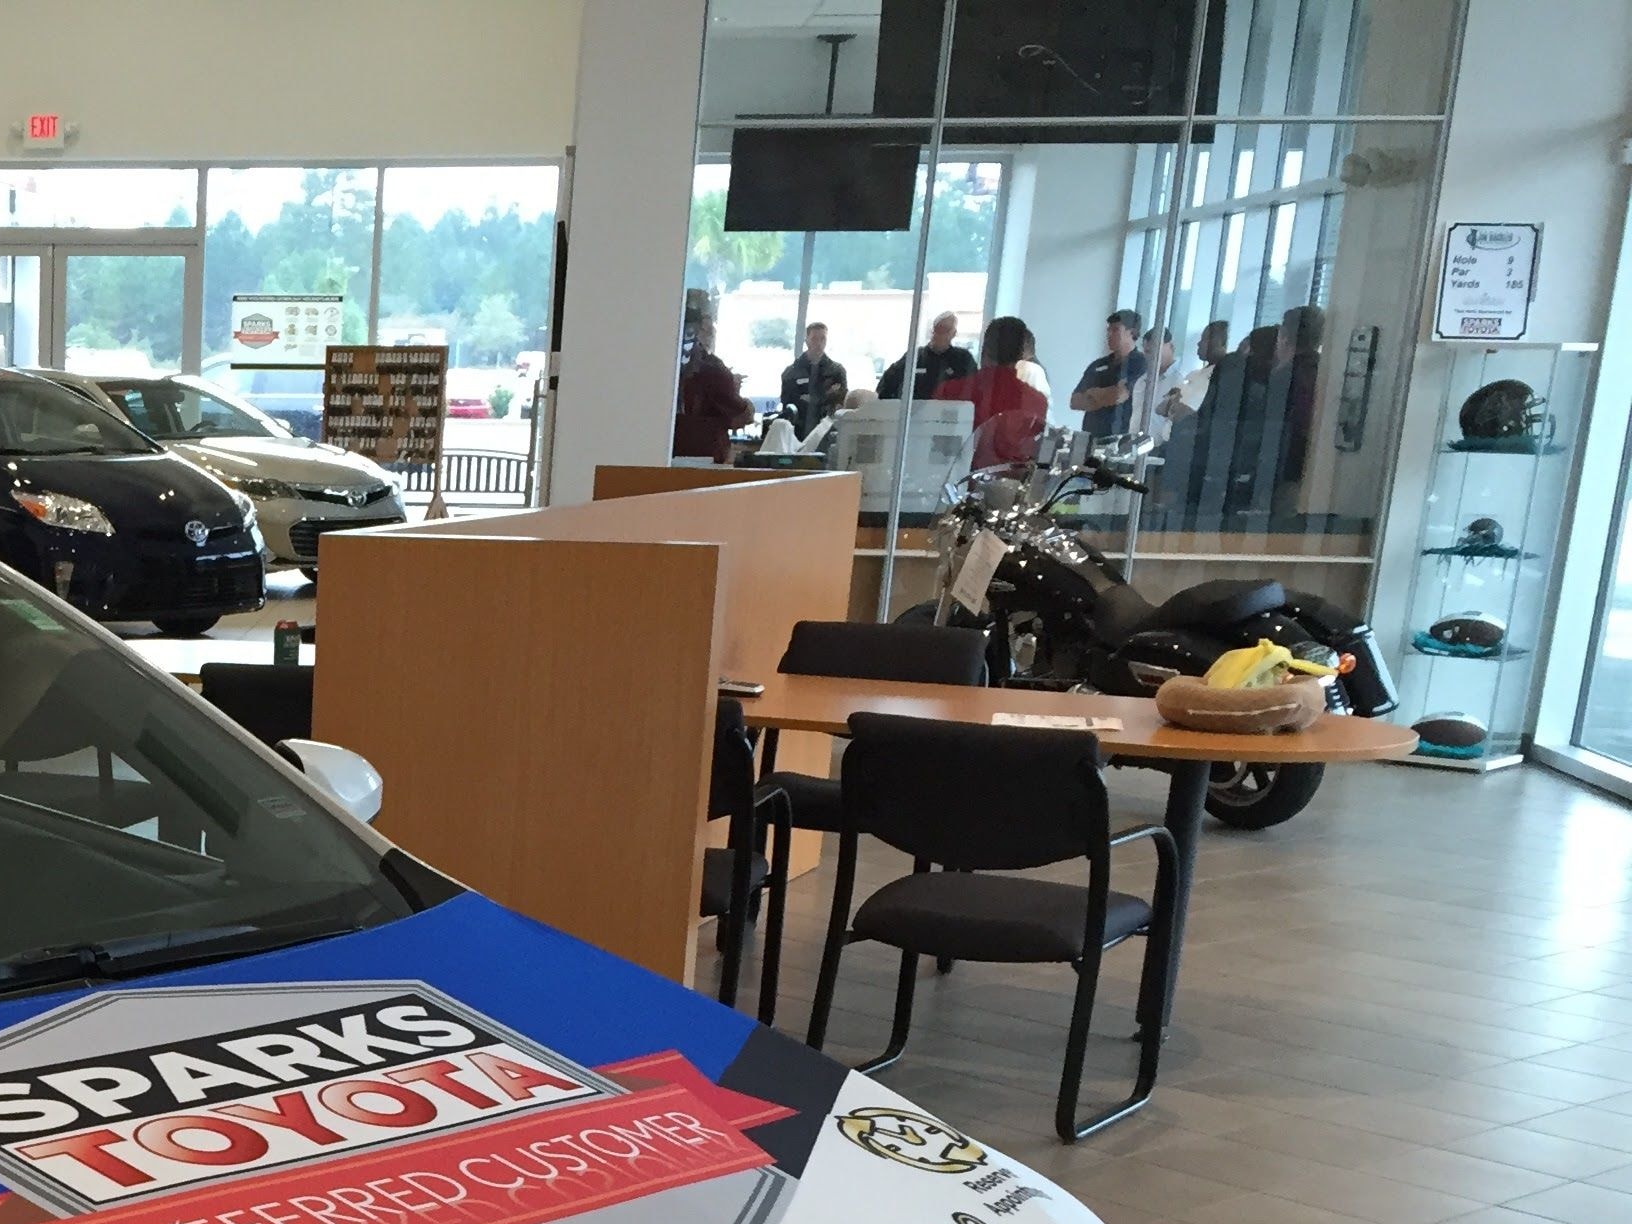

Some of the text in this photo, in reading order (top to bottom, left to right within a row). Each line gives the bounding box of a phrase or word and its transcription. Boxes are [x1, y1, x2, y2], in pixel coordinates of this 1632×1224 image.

[31, 116, 59, 138] EXIT
[1453, 255, 1515, 265] Hole 9
[1451, 267, 1471, 276] Par
[1451, 279, 1481, 289] Yards
[17, 1052, 583, 1188] TOYOTA
[459, 1111, 725, 1190] CUSTOMER
